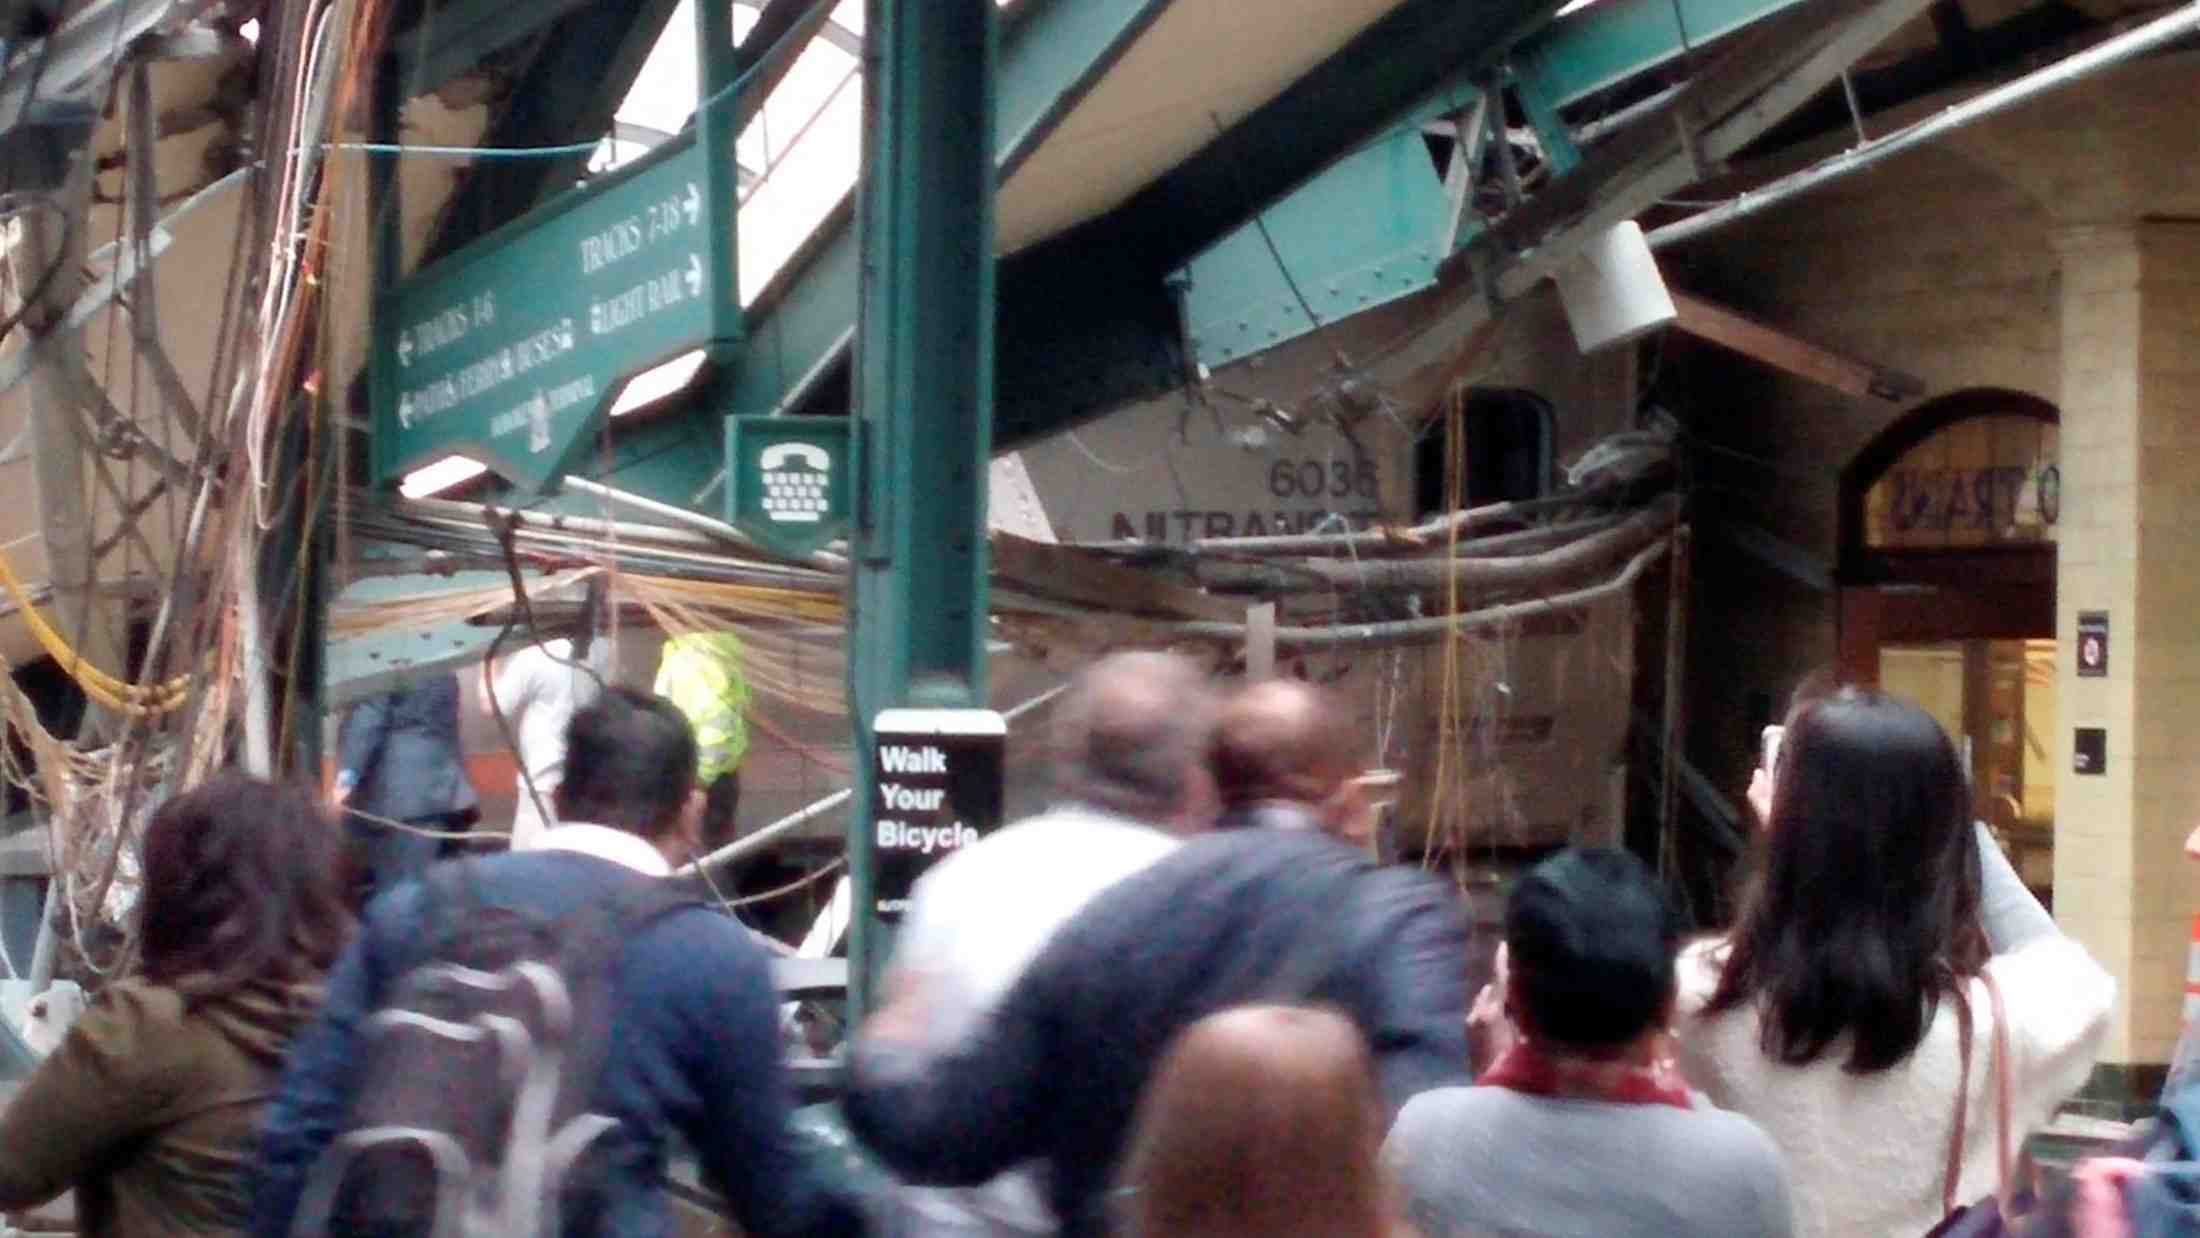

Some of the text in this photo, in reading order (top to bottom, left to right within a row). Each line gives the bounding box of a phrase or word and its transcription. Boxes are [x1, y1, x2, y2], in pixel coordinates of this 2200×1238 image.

[581, 216, 640, 274] TRACKS
[880, 745, 947, 773] Walk
[880, 782, 944, 810] Your
[877, 819, 979, 853] Bicycle
